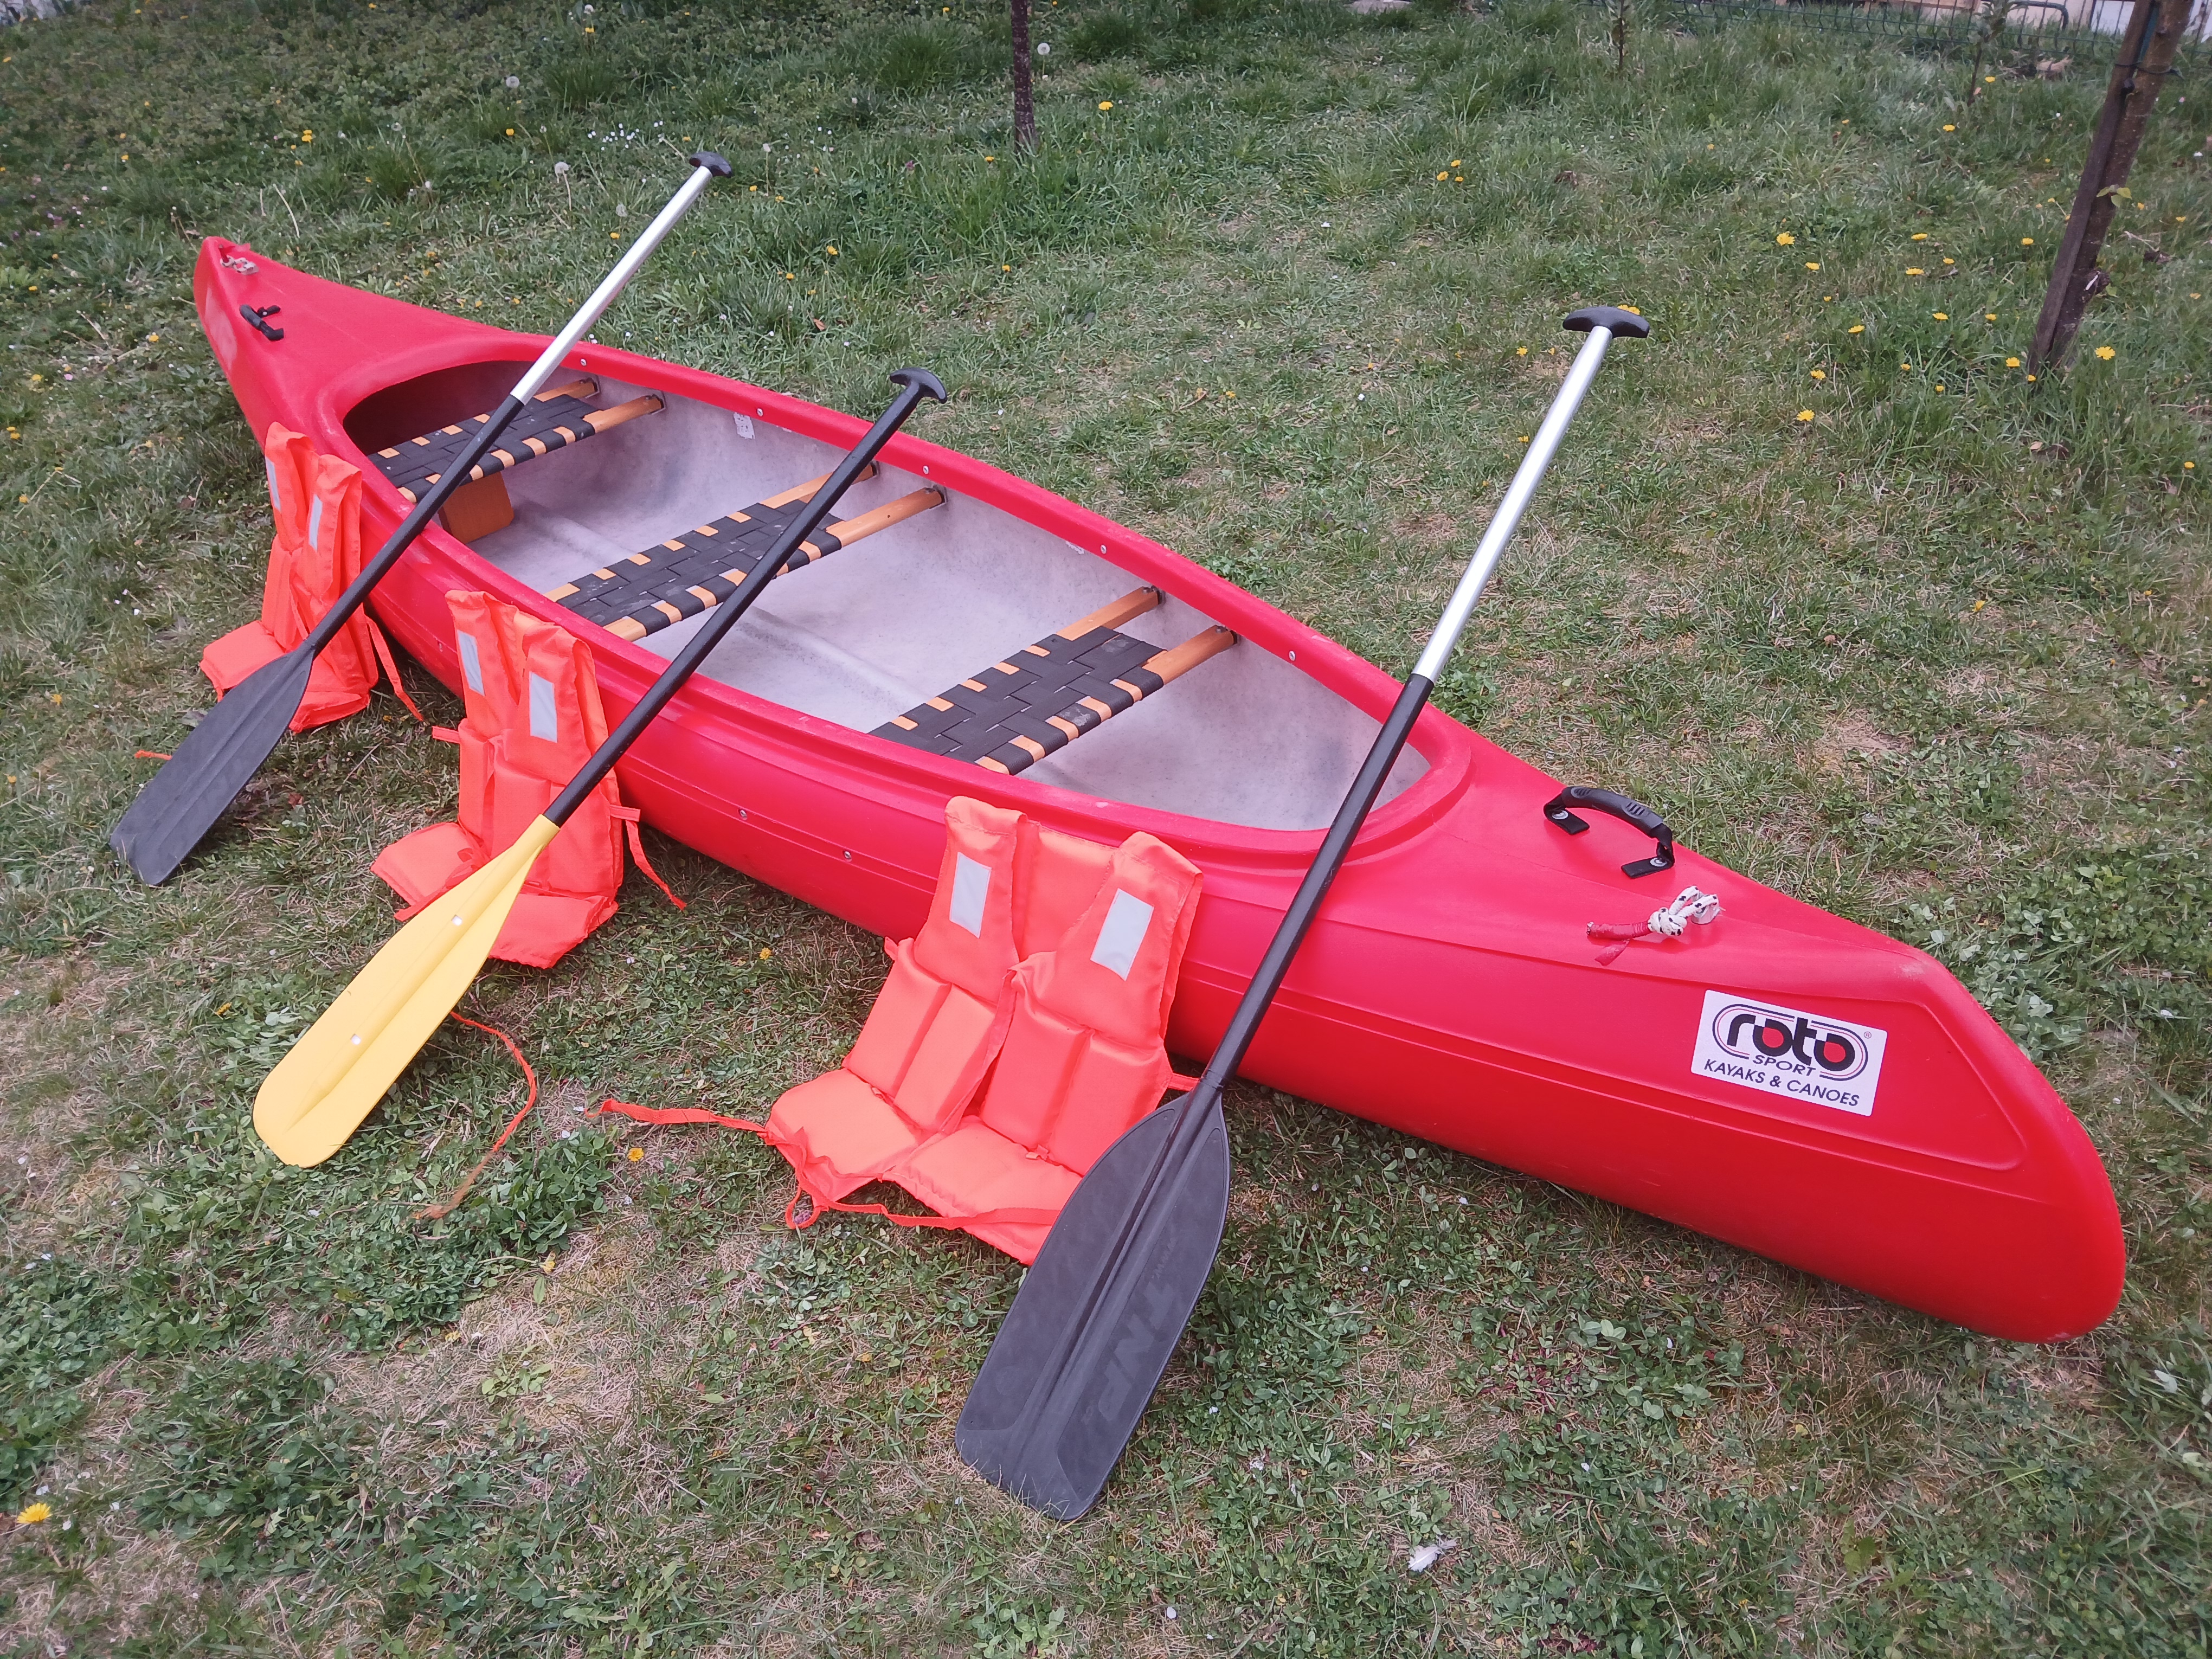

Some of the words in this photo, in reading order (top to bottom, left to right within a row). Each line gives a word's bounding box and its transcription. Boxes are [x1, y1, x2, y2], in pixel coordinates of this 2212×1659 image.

[1726, 1013, 1855, 1071] roto
[1753, 1054, 1816, 1076] SPORT
[1703, 1058, 1766, 1084] KAYAKS
[1769, 1075, 1780, 1088] &
[1786, 1079, 1860, 1107] CANOES
